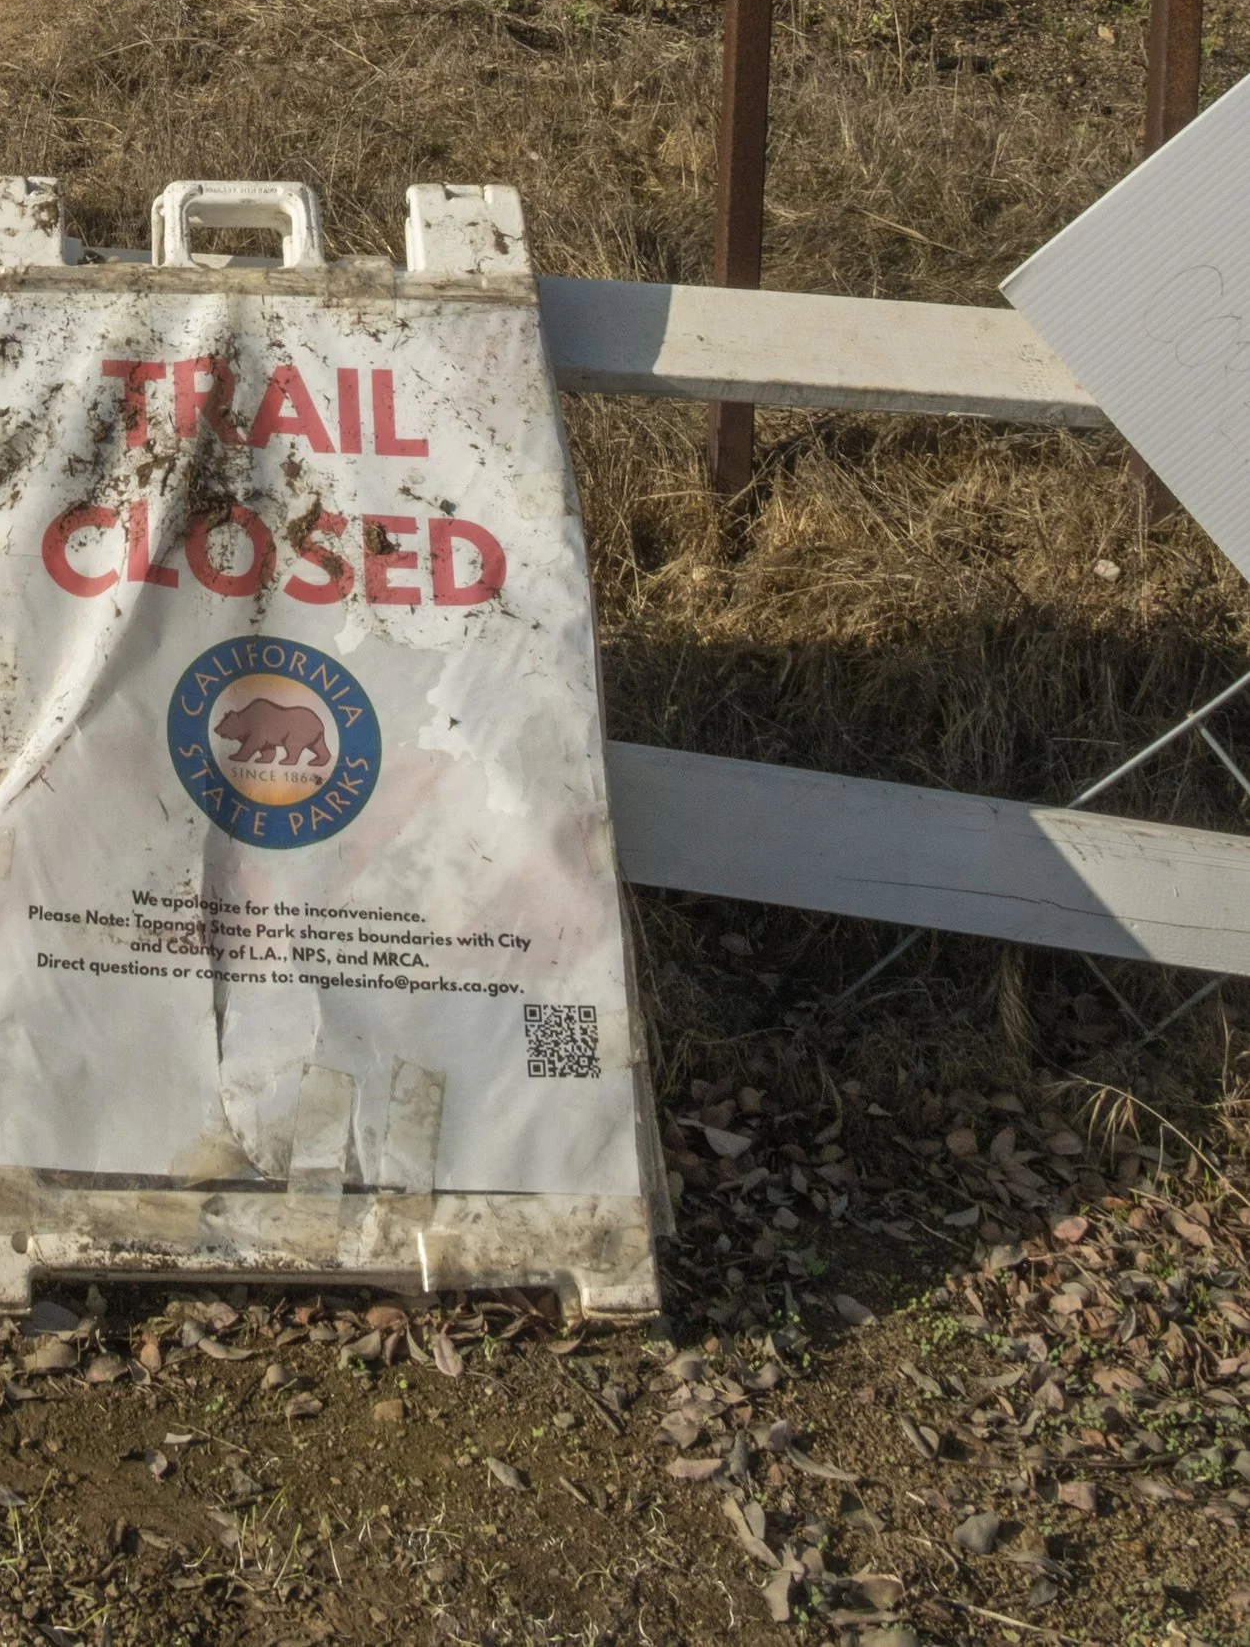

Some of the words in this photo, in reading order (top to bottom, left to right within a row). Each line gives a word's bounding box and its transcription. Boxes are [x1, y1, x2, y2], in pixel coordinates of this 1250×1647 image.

[101, 358, 430, 458] TRAIL
[41, 501, 508, 607] CLOSED
[181, 643, 364, 729] CALIFORNIA
[178, 742, 268, 837] STATE
[288, 756, 370, 836] PARKS
[231, 767, 276, 782] SINCE
[28, 905, 81, 924] Please
[85, 910, 130, 928] Note:
[134, 913, 206, 937] Topanga
[210, 920, 251, 937] State
[256, 924, 295, 939] Park
[300, 924, 354, 942] shares
[358, 927, 452, 946] boundaries
[456, 932, 494, 947] with
[498, 933, 532, 952] City
[132, 890, 158, 906] We
[161, 894, 241, 916] apologize
[245, 901, 269, 915] for
[274, 901, 300, 916] the
[304, 903, 426, 923] inconvenience.
[37, 953, 85, 971] Direct
[89, 960, 168, 978] questions
[172, 966, 191, 978] or
[196, 967, 267, 983] concerns
[271, 971, 294, 983] to:
[298, 972, 525, 997] angelesinfo@parks.ca.gov.
[130, 938, 162, 953] and
[166, 938, 225, 959] County
[229, 944, 246, 959] of
[249, 946, 288, 963] L.A.,
[292, 947, 331, 965] NPS,
[336, 950, 368, 966] and
[373, 952, 430, 968] MRCA.
